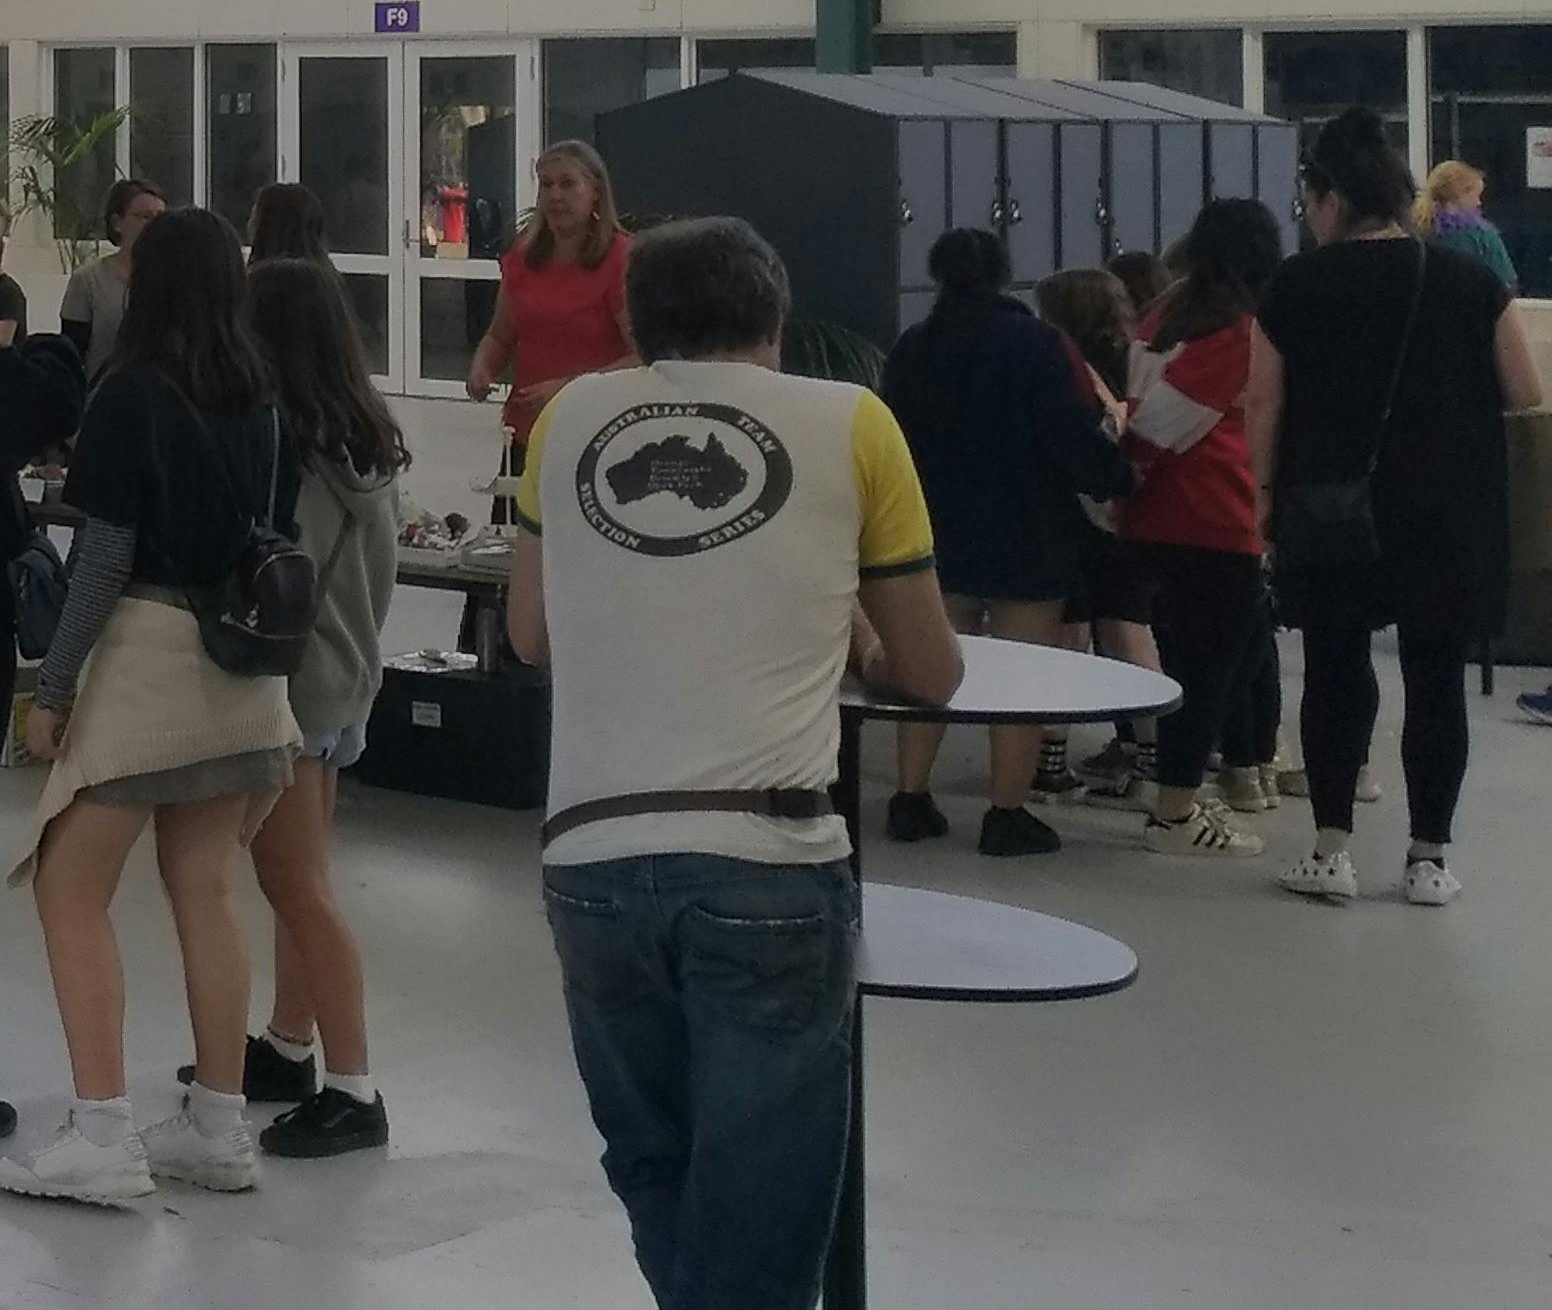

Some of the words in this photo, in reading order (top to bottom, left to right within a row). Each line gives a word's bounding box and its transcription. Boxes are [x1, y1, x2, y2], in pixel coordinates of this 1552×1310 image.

[387, 8, 408, 27] F9
[595, 406, 699, 450] AUSTRALIAN
[739, 417, 777, 452] TEAM
[580, 482, 640, 548] SELECTION
[698, 509, 765, 547] SERIES
